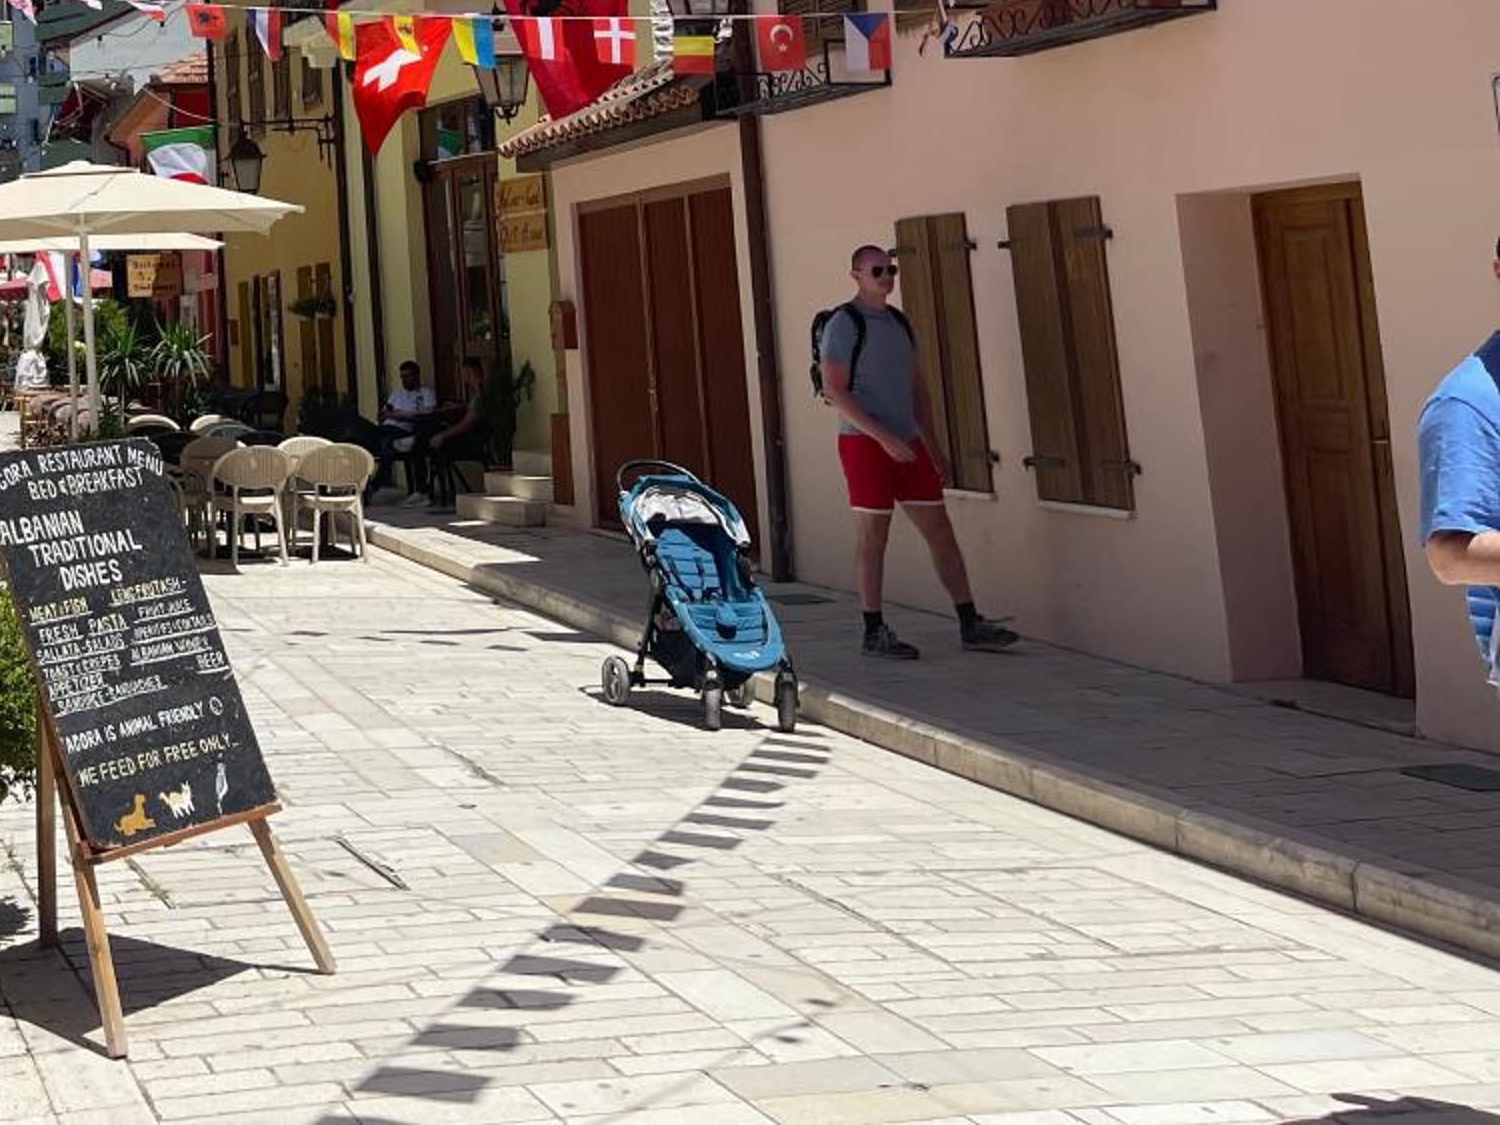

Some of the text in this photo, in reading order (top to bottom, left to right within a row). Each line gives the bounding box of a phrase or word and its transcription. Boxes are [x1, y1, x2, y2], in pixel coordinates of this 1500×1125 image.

[38, 445, 124, 474] RESTAURANT
[127, 446, 164, 476] MENU
[28, 479, 57, 500] BED
[66, 467, 143, 495] BREAKFAST
[0, 510, 84, 545] ALBANIAN
[28, 528, 143, 567] TRADITIONAL
[60, 558, 123, 591] DISHES
[39, 613, 129, 643] FRESH PASTA
[197, 650, 225, 669] BEER
[104, 725, 116, 742] IS
[119, 715, 158, 738] ANIMAL
[157, 701, 203, 727] FRIENDLY
[78, 766, 98, 787] WE
[100, 756, 136, 780] FEED
[137, 750, 163, 771] FOR
[163, 741, 198, 763] FREE
